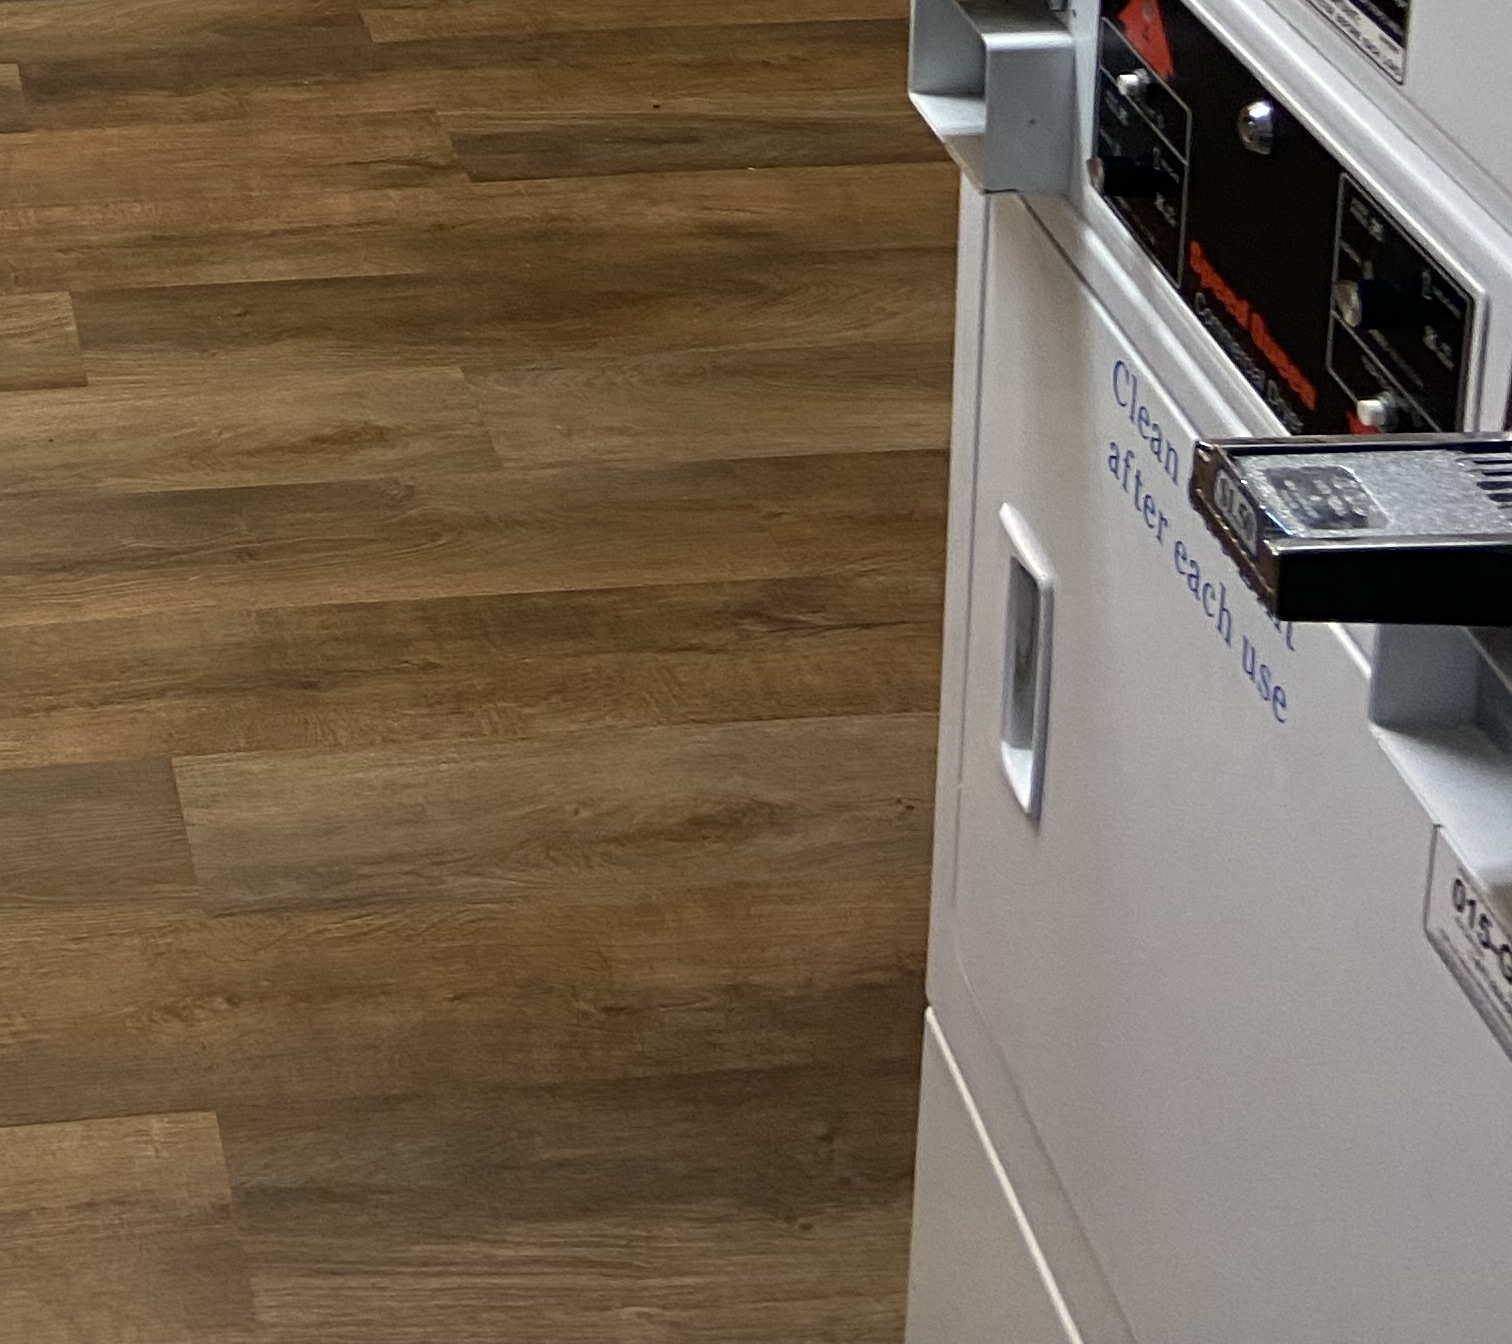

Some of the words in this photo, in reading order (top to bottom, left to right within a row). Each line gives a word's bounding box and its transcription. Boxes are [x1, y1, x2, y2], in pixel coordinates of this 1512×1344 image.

[1112, 359, 1180, 487] Clean
[1107, 441, 1169, 544] after
[1174, 539, 1233, 649] each
[1242, 634, 1288, 724] use
